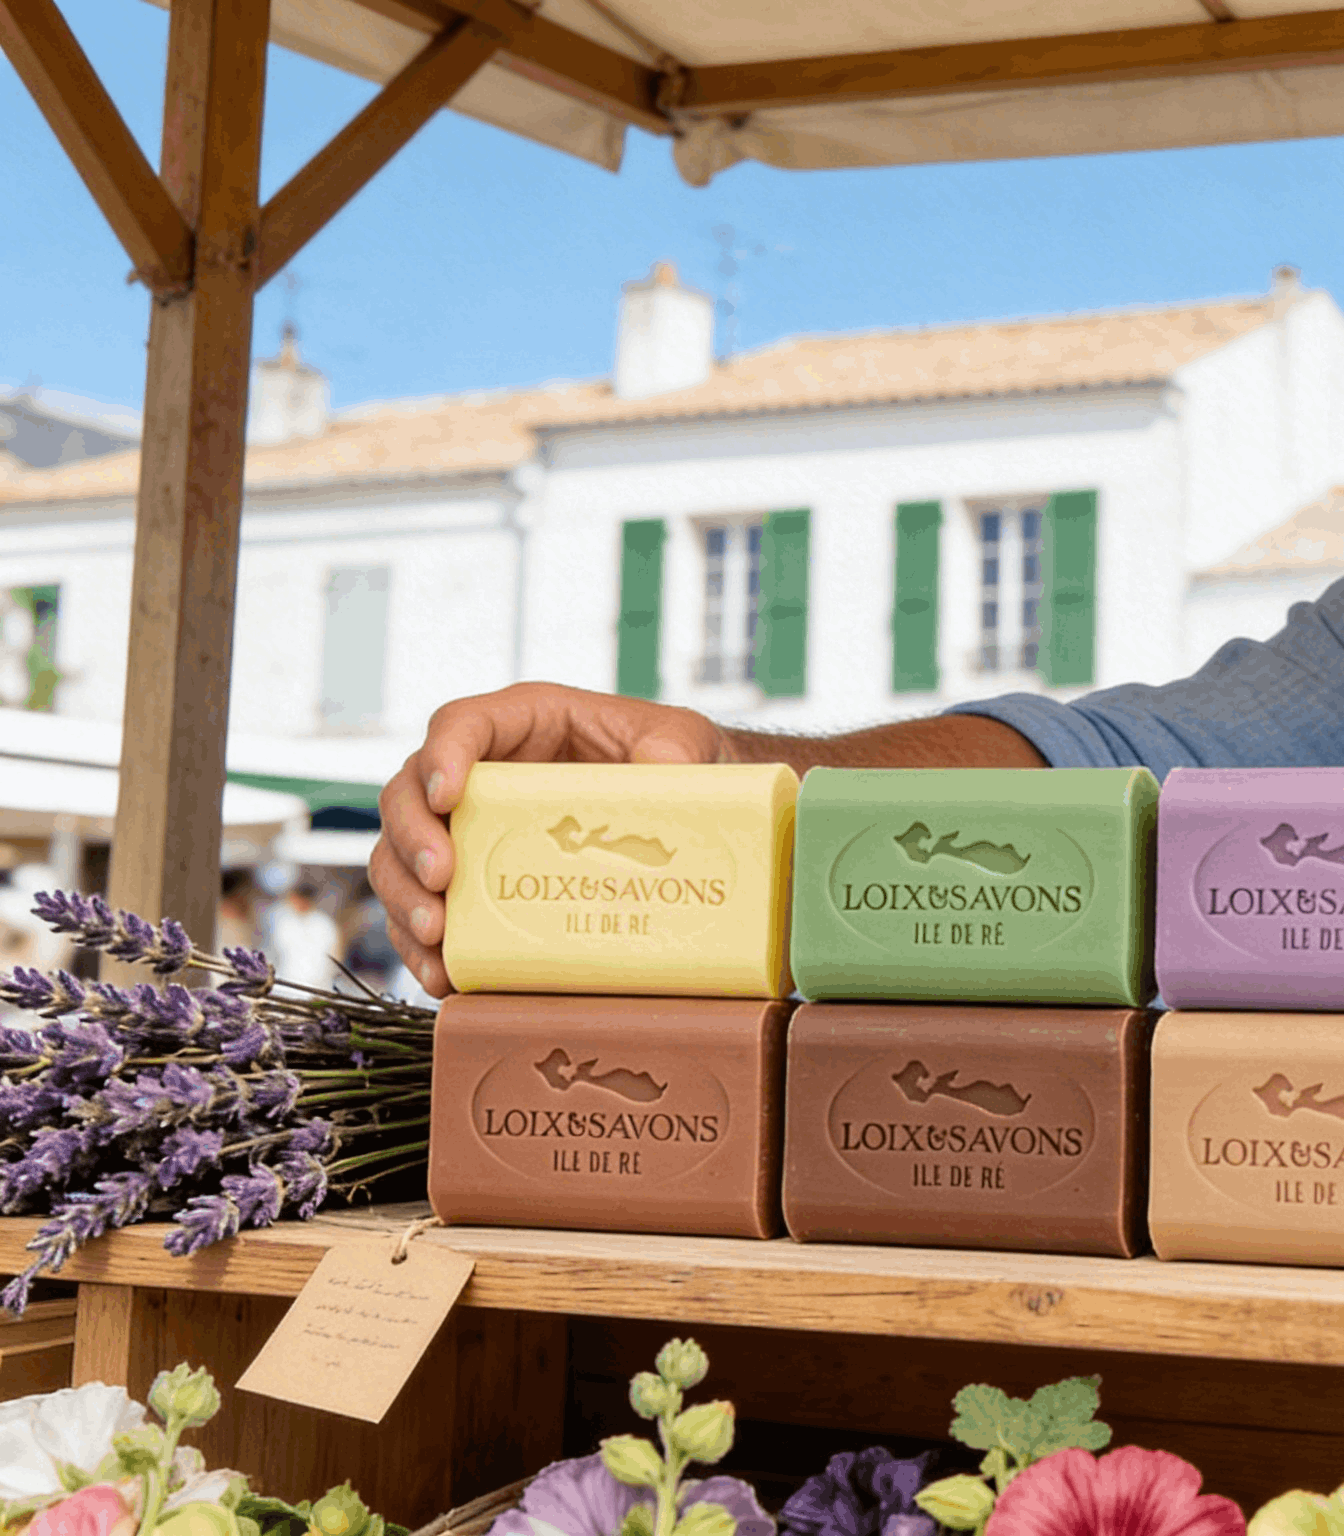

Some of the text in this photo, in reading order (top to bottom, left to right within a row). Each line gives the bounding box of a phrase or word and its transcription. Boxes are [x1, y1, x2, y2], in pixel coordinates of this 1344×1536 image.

[498, 874, 726, 906] LOIX&SAVONS
[842, 883, 1082, 913] LOIX&SAVONS
[566, 913, 591, 934] ILE
[601, 914, 621, 934] DE
[914, 922, 942, 944] ILE
[951, 923, 973, 944] DE
[1282, 927, 1310, 950] ILE
[1320, 927, 1344, 950] DE
[484, 1109, 719, 1142] LOIX&SAVONS
[841, 1122, 1083, 1156] LOIX&SAVONS
[553, 1149, 581, 1172] ILE
[589, 1151, 612, 1173] DE
[913, 1161, 1005, 1189] ILE DE RÉ
[1276, 1180, 1304, 1203] ILE
[1314, 1181, 1338, 1205] DE
